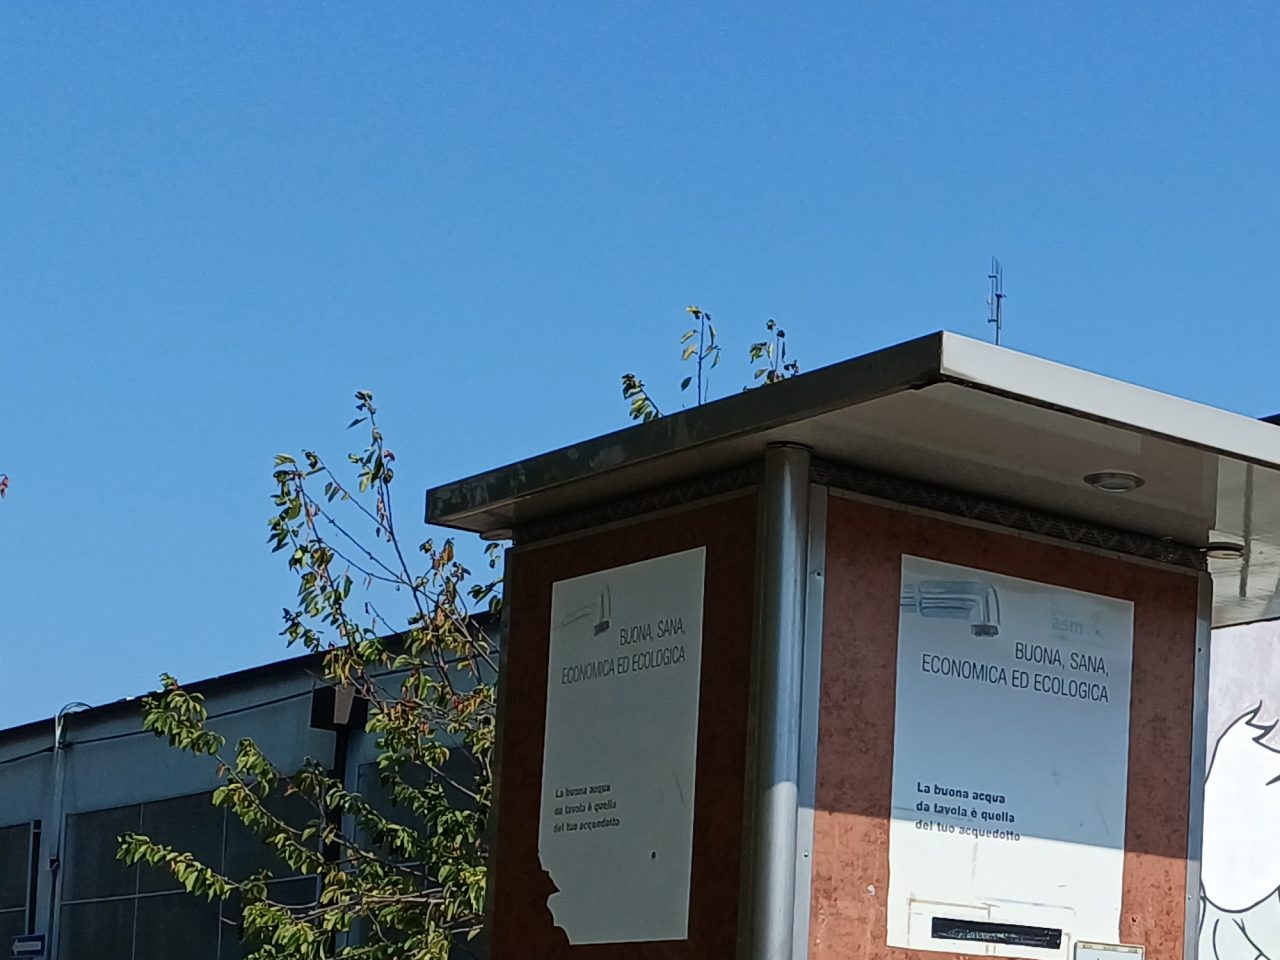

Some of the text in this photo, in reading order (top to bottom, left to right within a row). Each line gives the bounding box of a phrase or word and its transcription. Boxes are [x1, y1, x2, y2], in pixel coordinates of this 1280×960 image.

[620, 616, 686, 646] BUONA, SANA,
[562, 645, 686, 685] ECONOMICA ED ECOLOGICA
[1015, 641, 1109, 677] BUONA, SANA,
[921, 653, 1109, 703] ECONOMICA ED ECOLOGICA
[917, 782, 1006, 805] La buona acqua
[916, 801, 930, 813] da
[933, 802, 968, 817] tavola
[970, 806, 978, 819] è
[915, 820, 1021, 842] del tuo acquedotto
